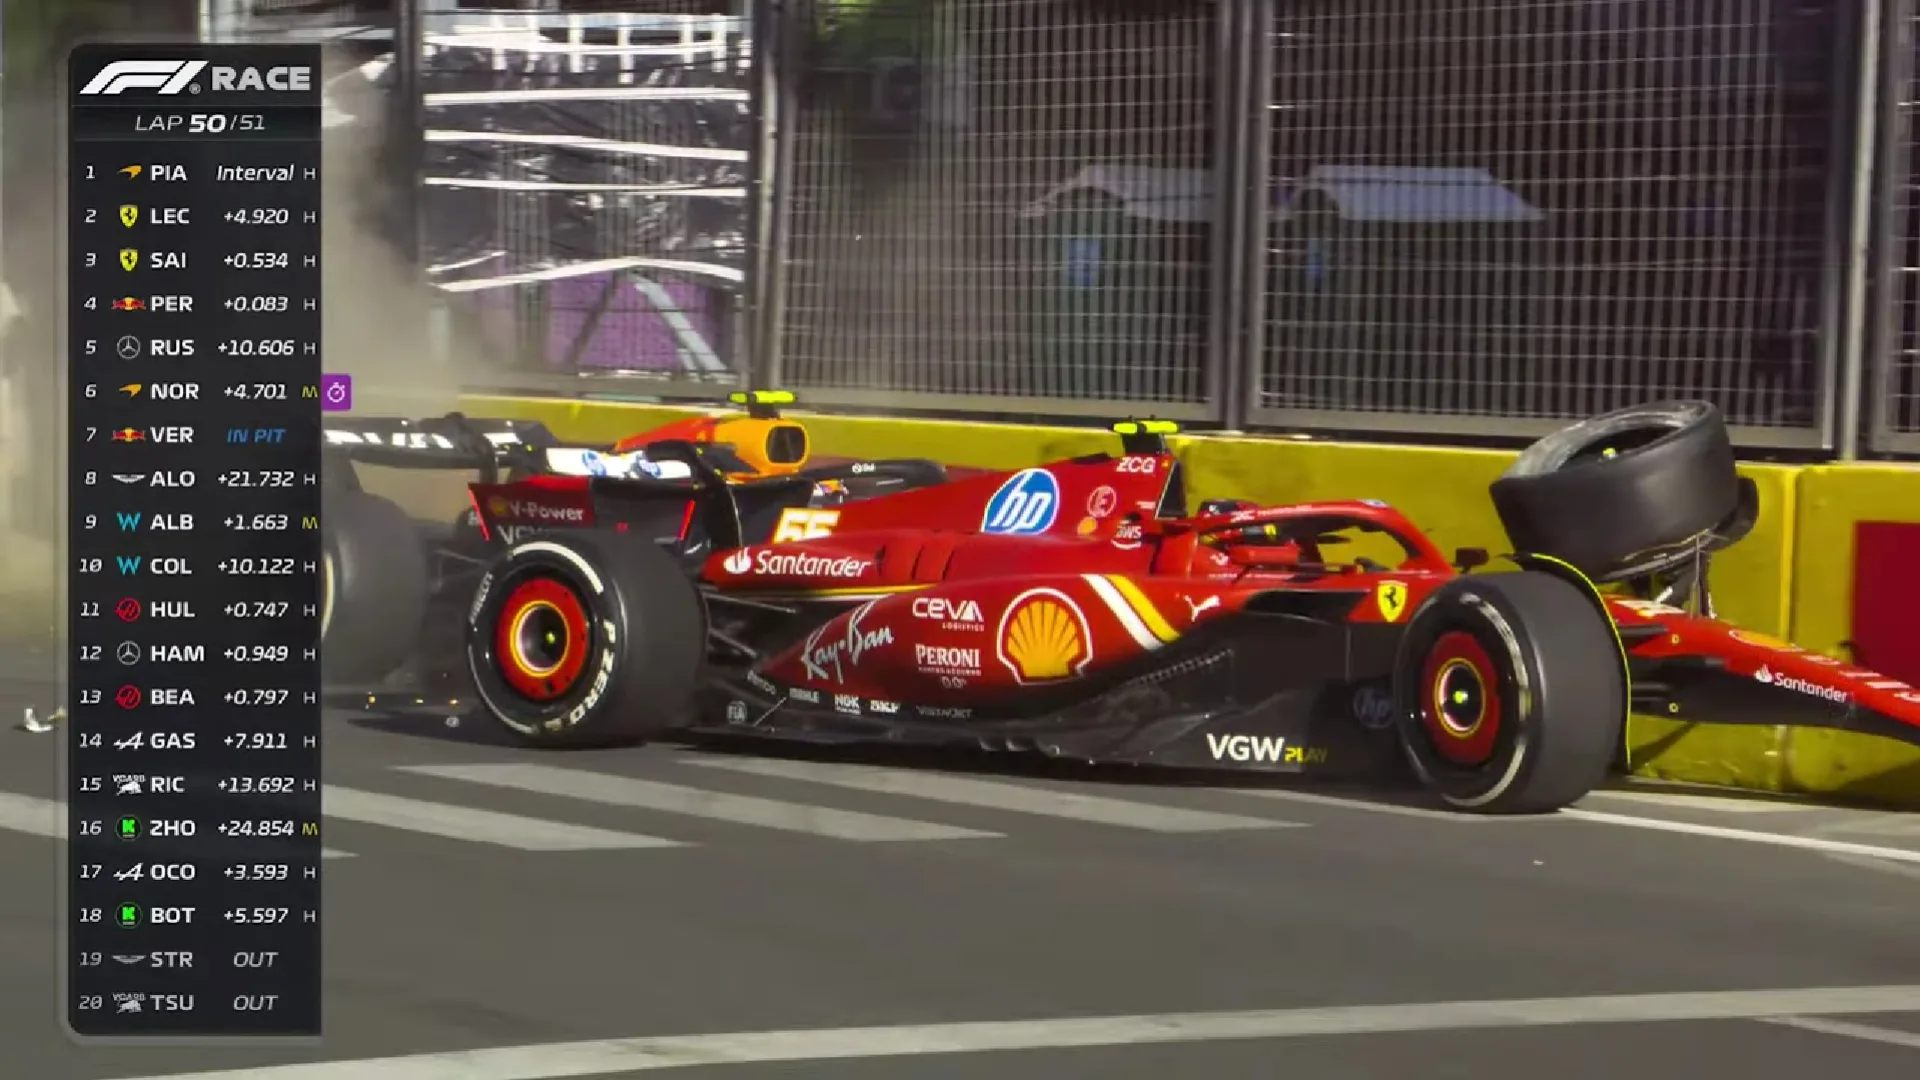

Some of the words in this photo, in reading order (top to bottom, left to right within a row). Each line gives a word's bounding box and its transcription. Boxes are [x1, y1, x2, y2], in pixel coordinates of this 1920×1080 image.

[1116, 457, 1156, 473] ZCG
[510, 503, 585, 521] V-Power
[989, 471, 1053, 537] hp
[755, 550, 873, 577] Santander
[915, 643, 982, 668] PERONI
[1773, 671, 1849, 704] Santander
[1206, 733, 1286, 763] VGW
